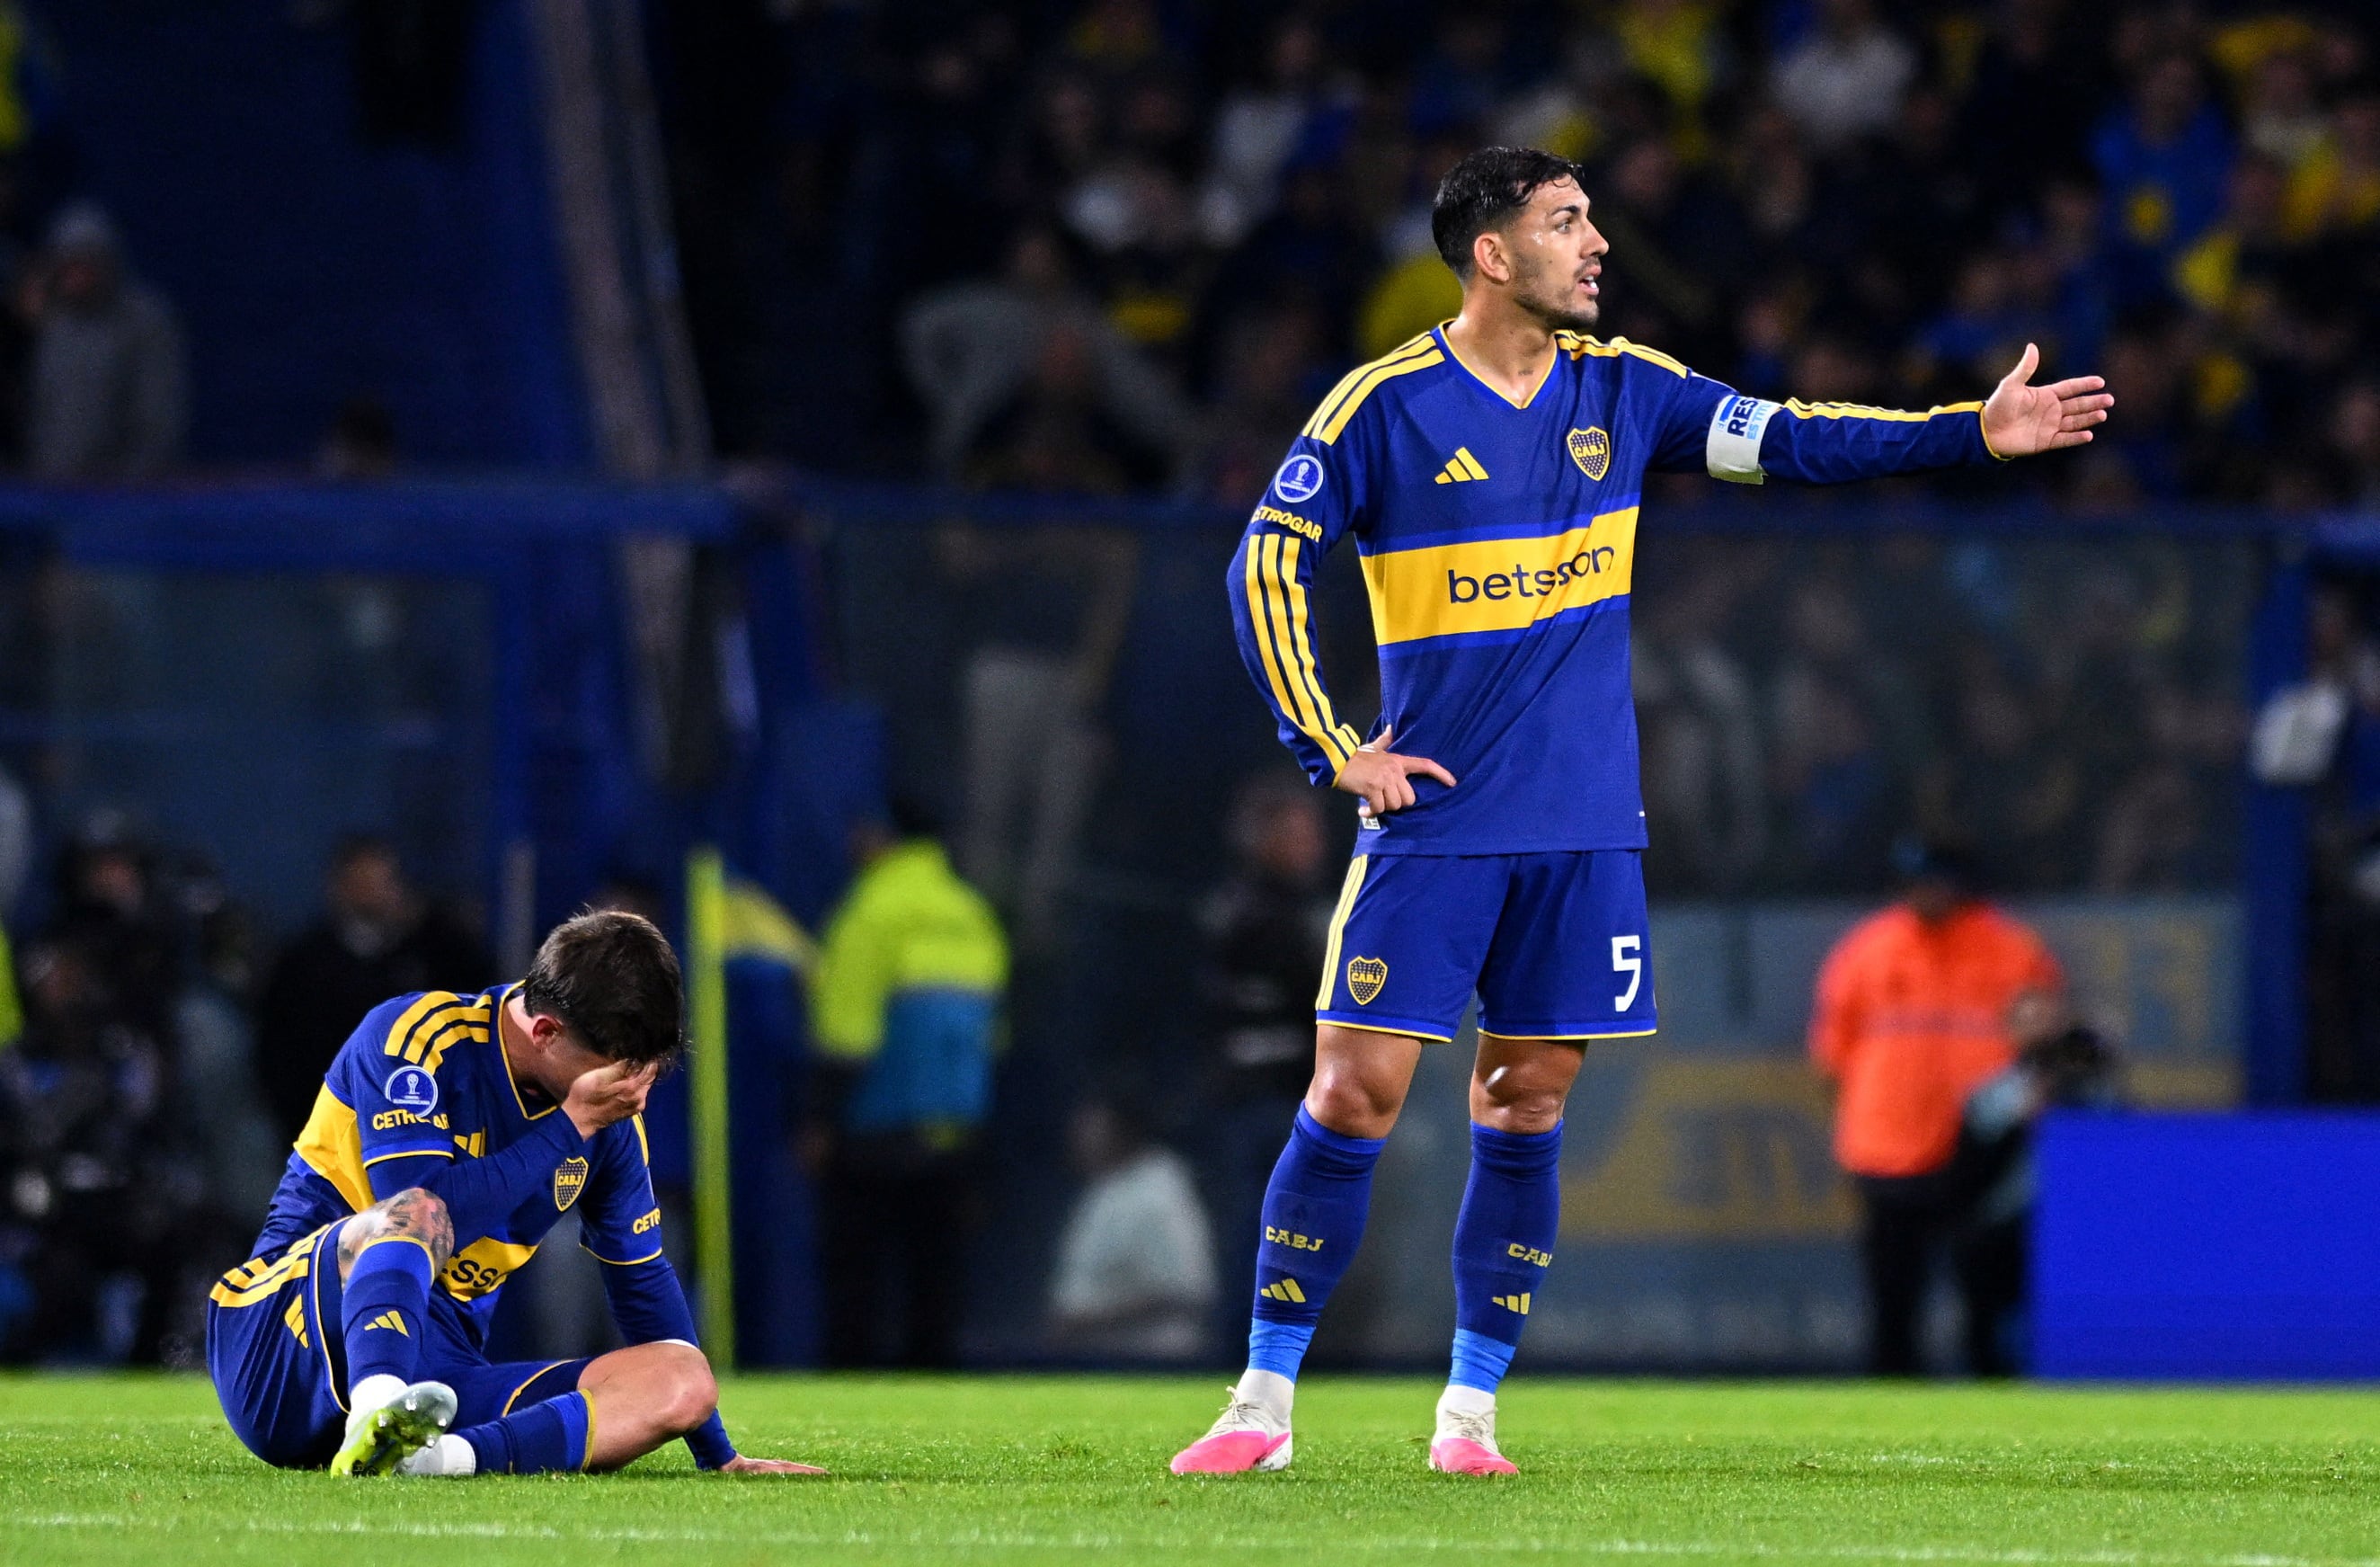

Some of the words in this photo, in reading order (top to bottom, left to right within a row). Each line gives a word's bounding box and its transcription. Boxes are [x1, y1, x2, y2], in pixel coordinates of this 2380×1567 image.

[1575, 443, 1605, 458] CABJ
[1448, 546, 1615, 603] betsson
[1352, 972, 1381, 984] CABJ
[1612, 935, 1641, 1012] 5
[557, 1174, 582, 1187] CABJ
[1265, 1225, 1324, 1251] CABJ
